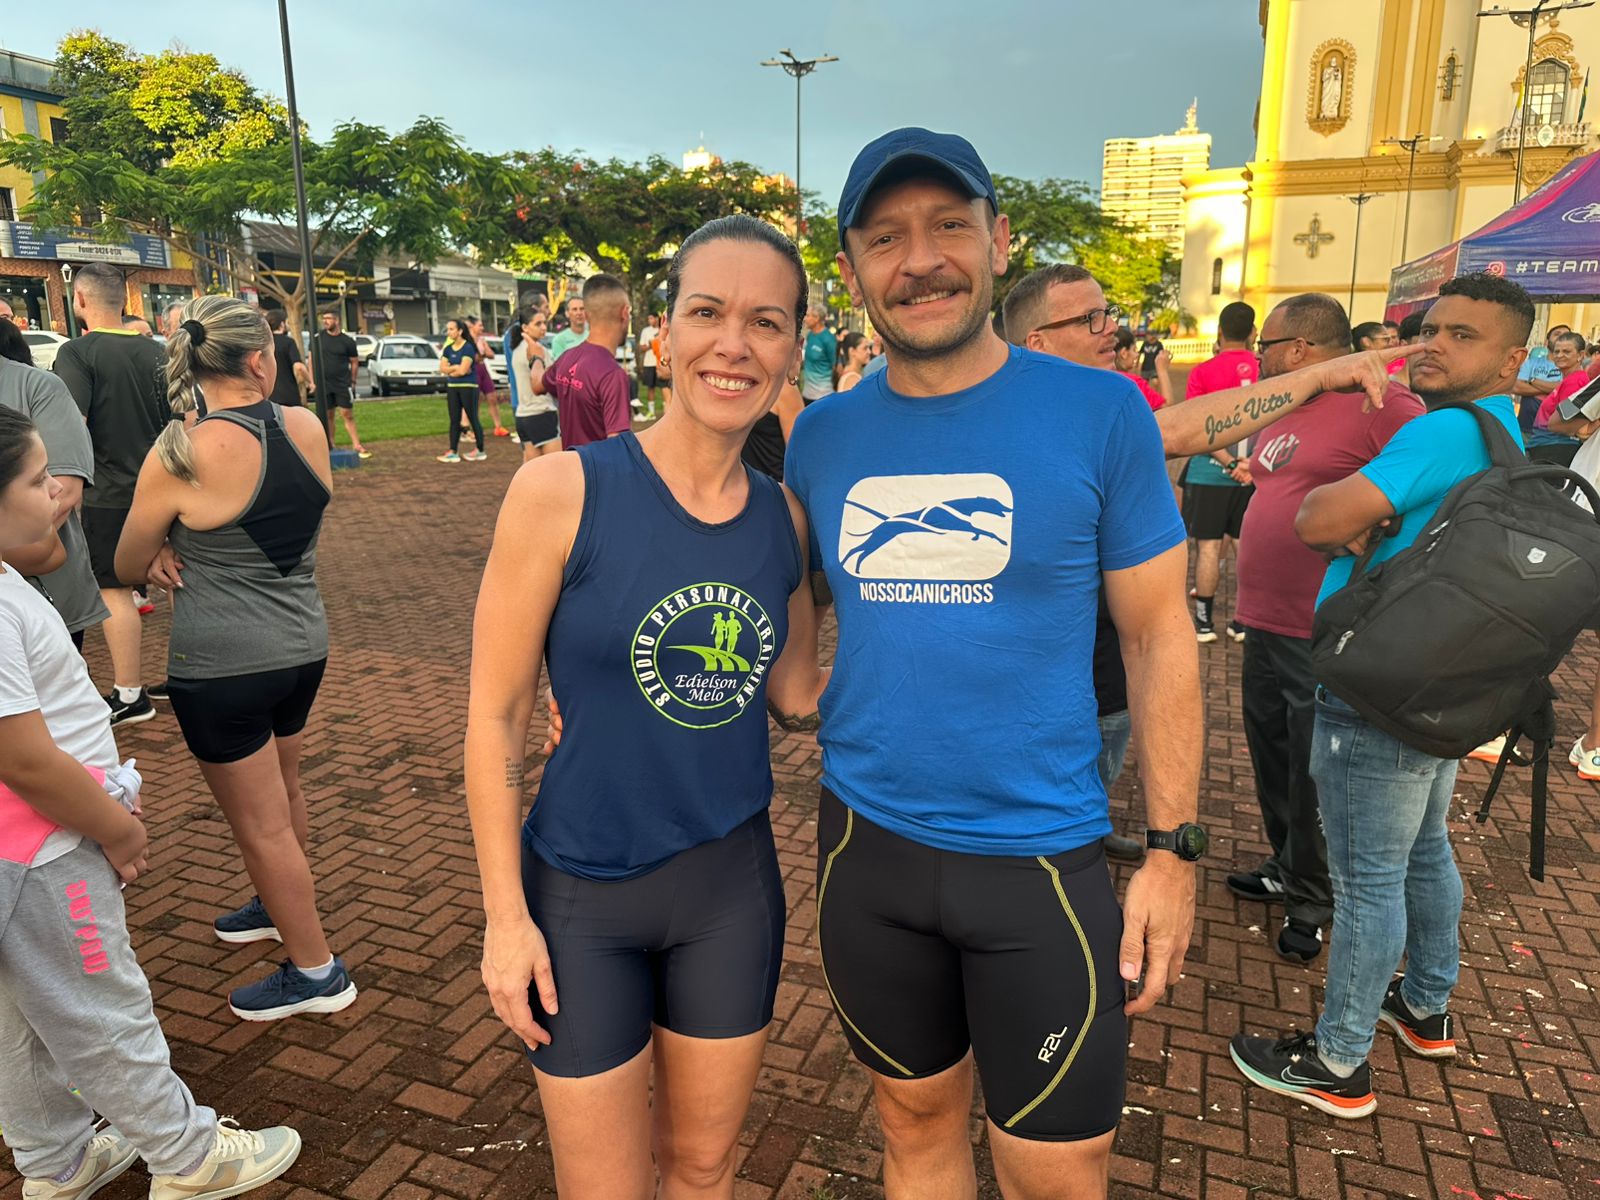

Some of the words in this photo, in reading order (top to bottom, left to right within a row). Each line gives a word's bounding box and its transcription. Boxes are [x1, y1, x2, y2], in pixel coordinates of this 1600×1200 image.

[1516, 260, 1599, 274] #TEAM
[1205, 404, 1242, 446] José
[1243, 391, 1294, 421] Vitor
[651, 585, 752, 627] PERSONAL
[634, 634, 671, 707] STUDIO
[735, 613, 773, 708] TRAINING
[674, 673, 738, 690] Edielson
[686, 687, 724, 702] Melo
[1037, 1026, 1068, 1063] R2L
